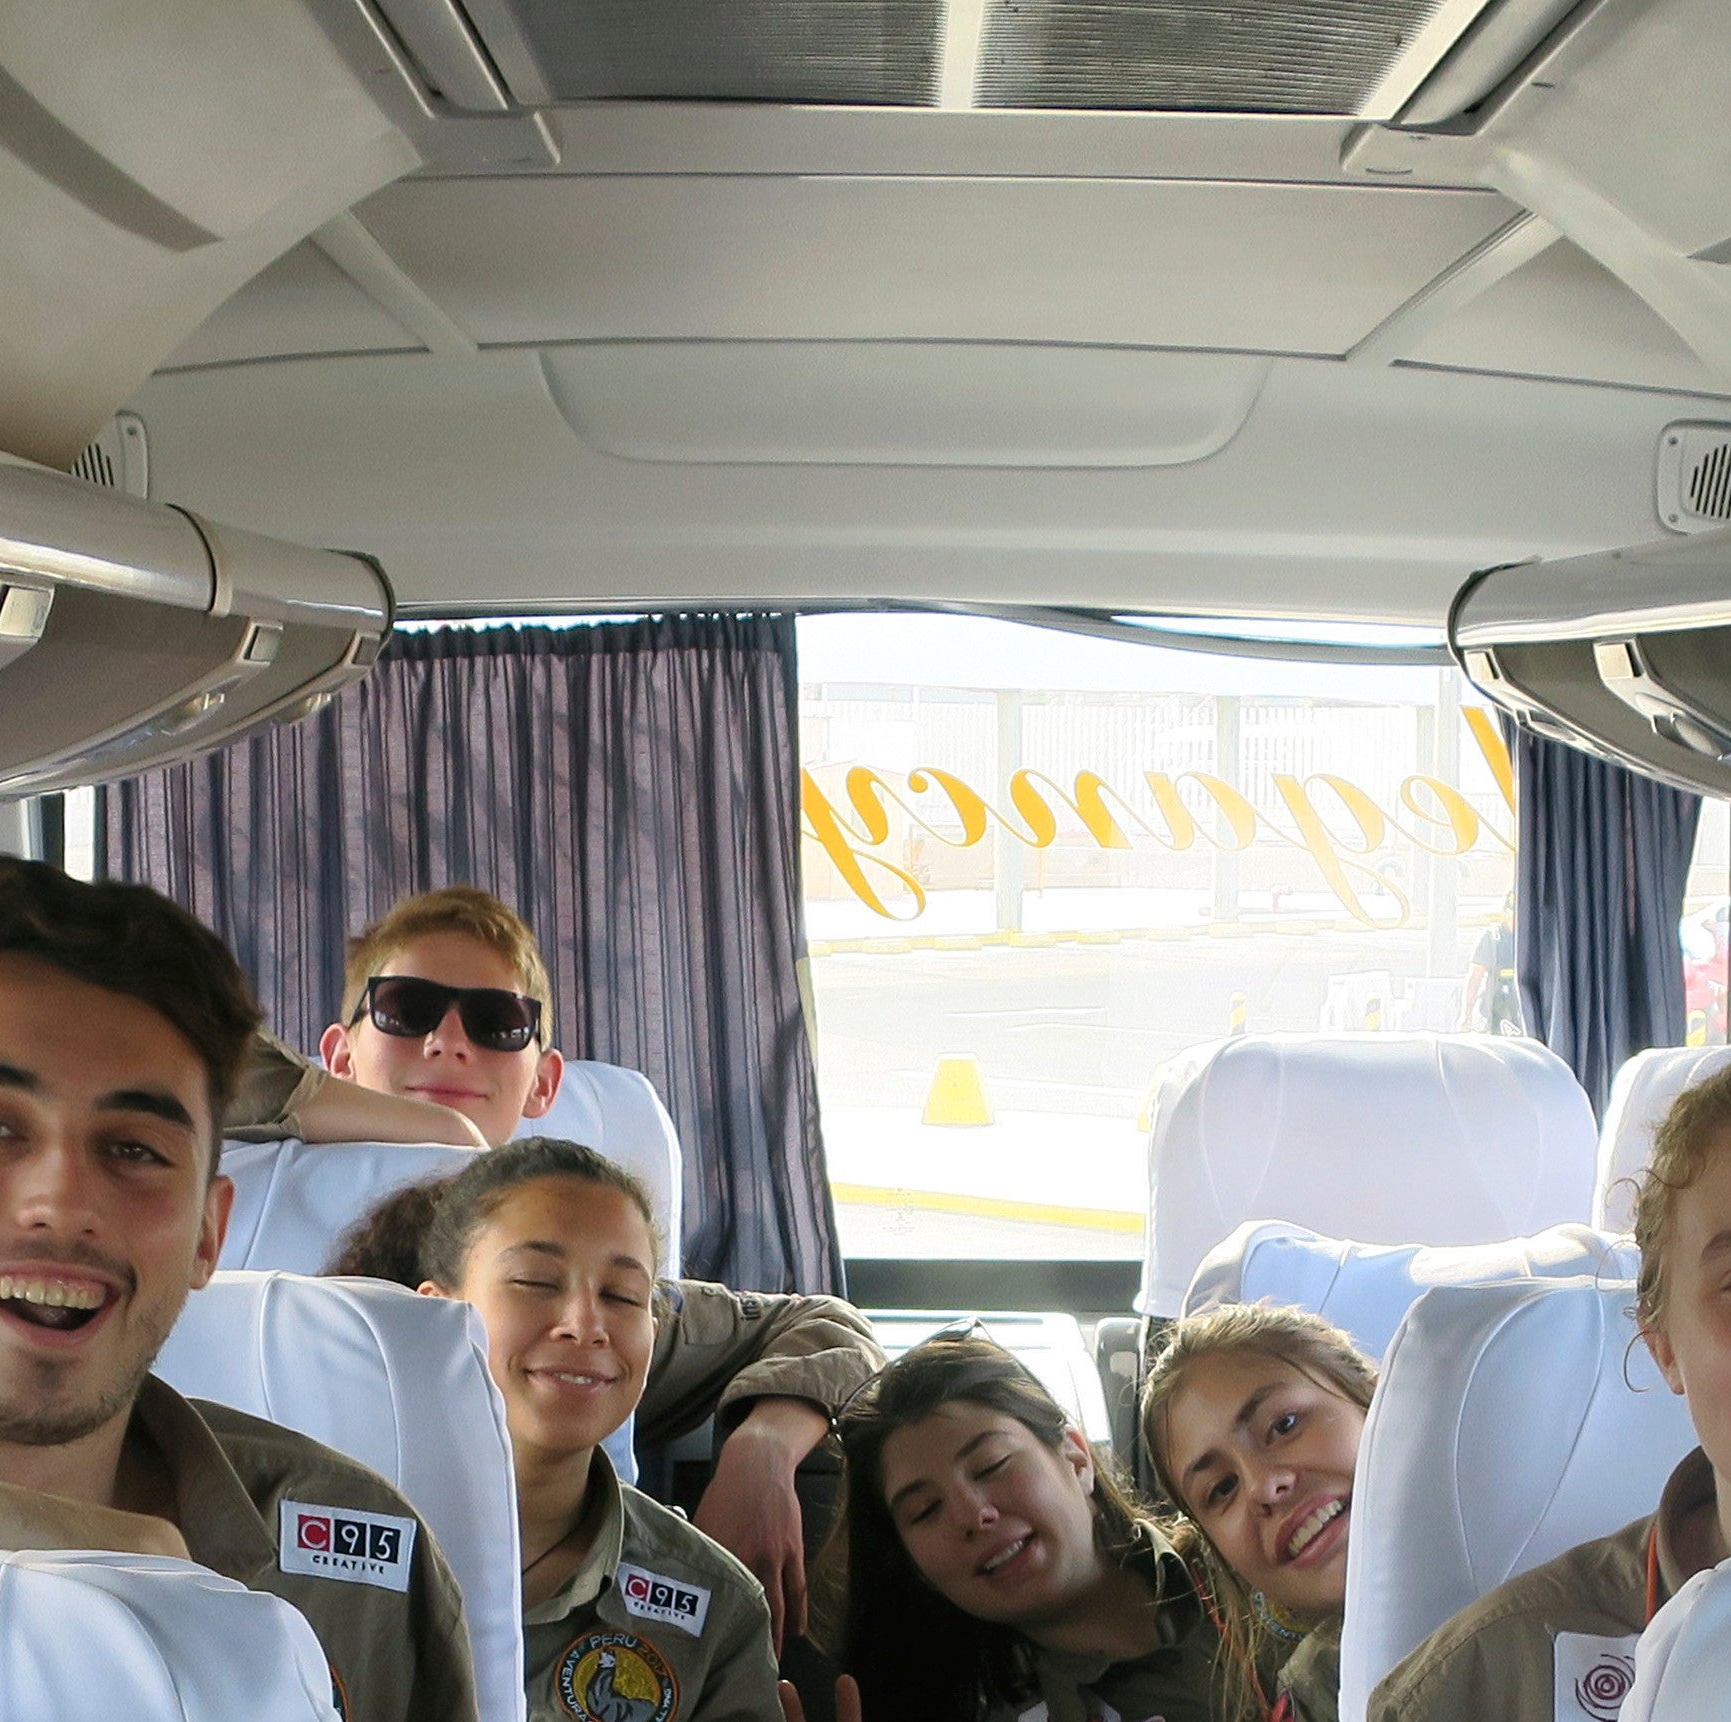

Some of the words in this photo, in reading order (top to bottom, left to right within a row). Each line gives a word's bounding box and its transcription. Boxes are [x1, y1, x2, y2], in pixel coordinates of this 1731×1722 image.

[299, 1518, 396, 1561] C95
[312, 1554, 385, 1575] CREATIVE
[627, 1577, 695, 1613] C95
